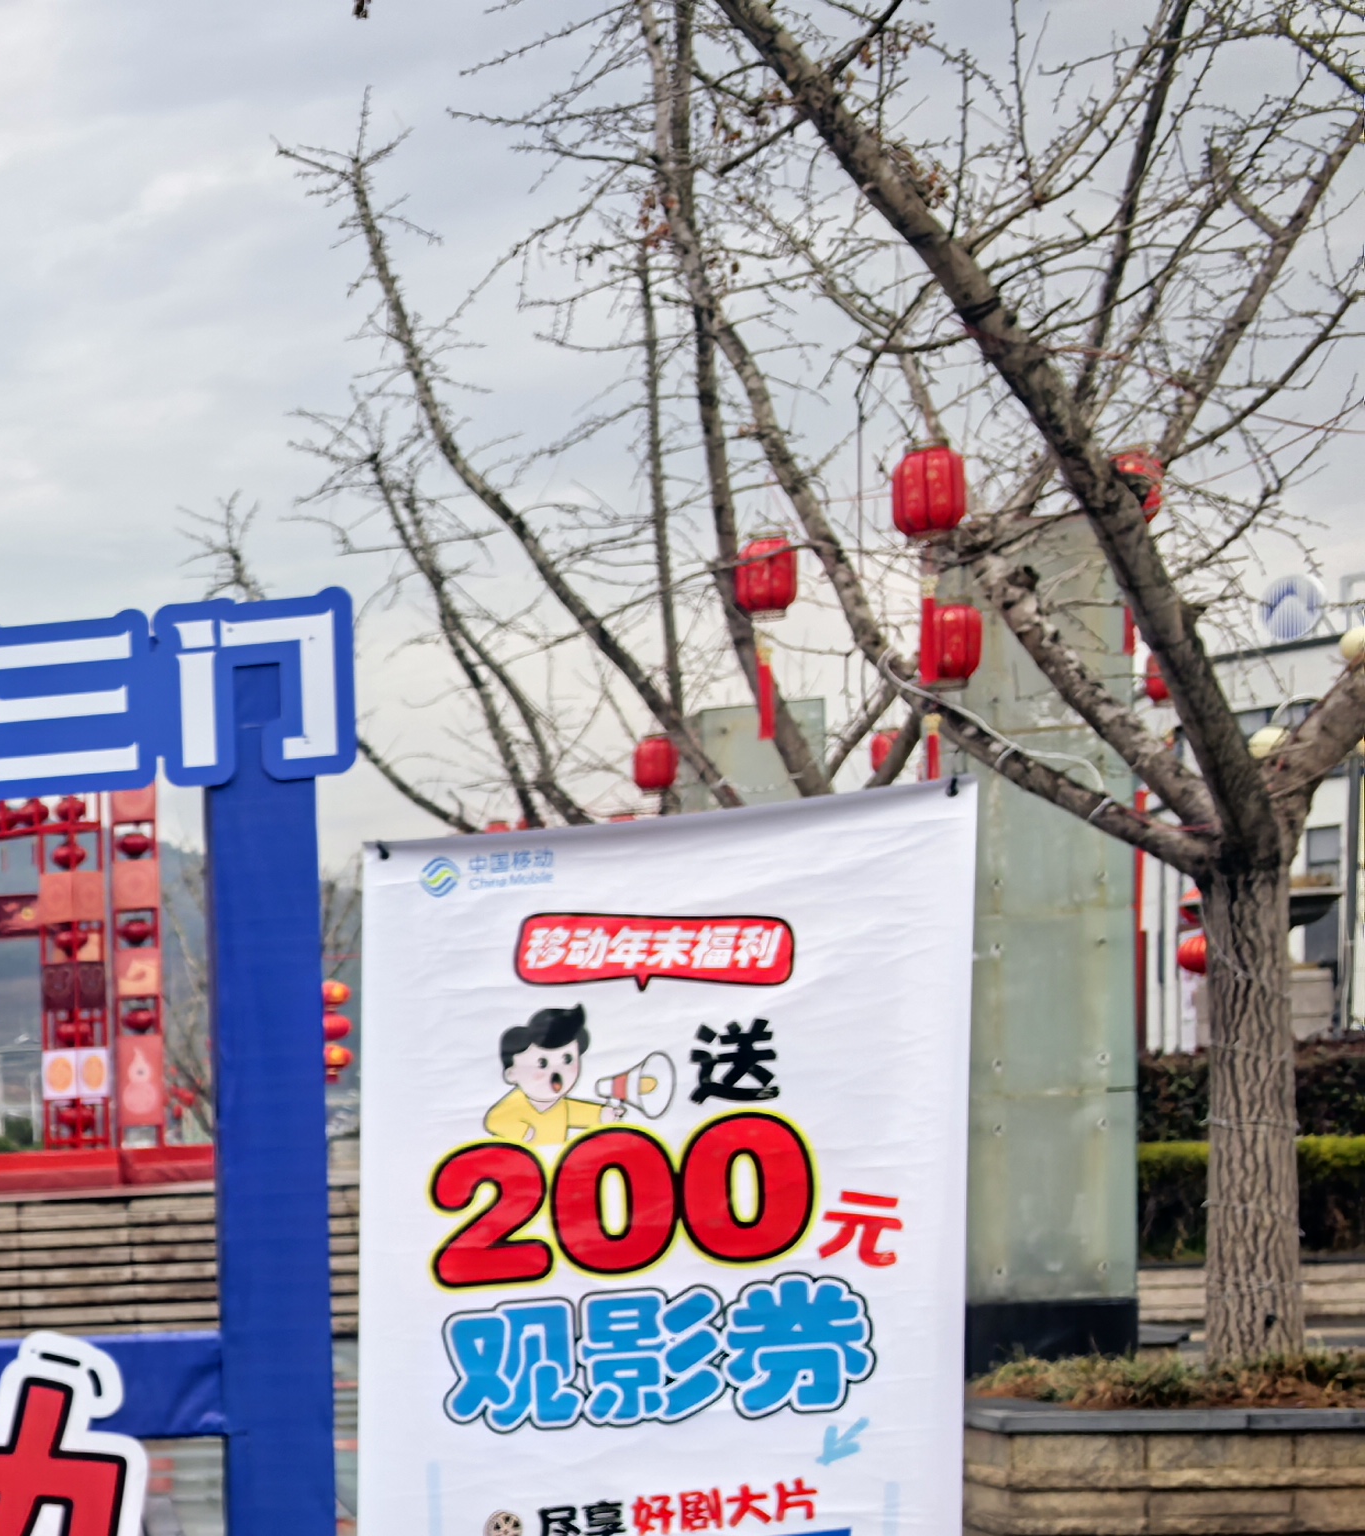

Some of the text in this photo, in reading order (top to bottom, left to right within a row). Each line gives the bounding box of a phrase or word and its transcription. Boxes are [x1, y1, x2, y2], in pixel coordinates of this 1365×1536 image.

[468, 847, 555, 873] 中国移动
[523, 924, 783, 971] 移动年末福利
[689, 1018, 781, 1104] 送
[441, 1271, 876, 1433] 观影券
